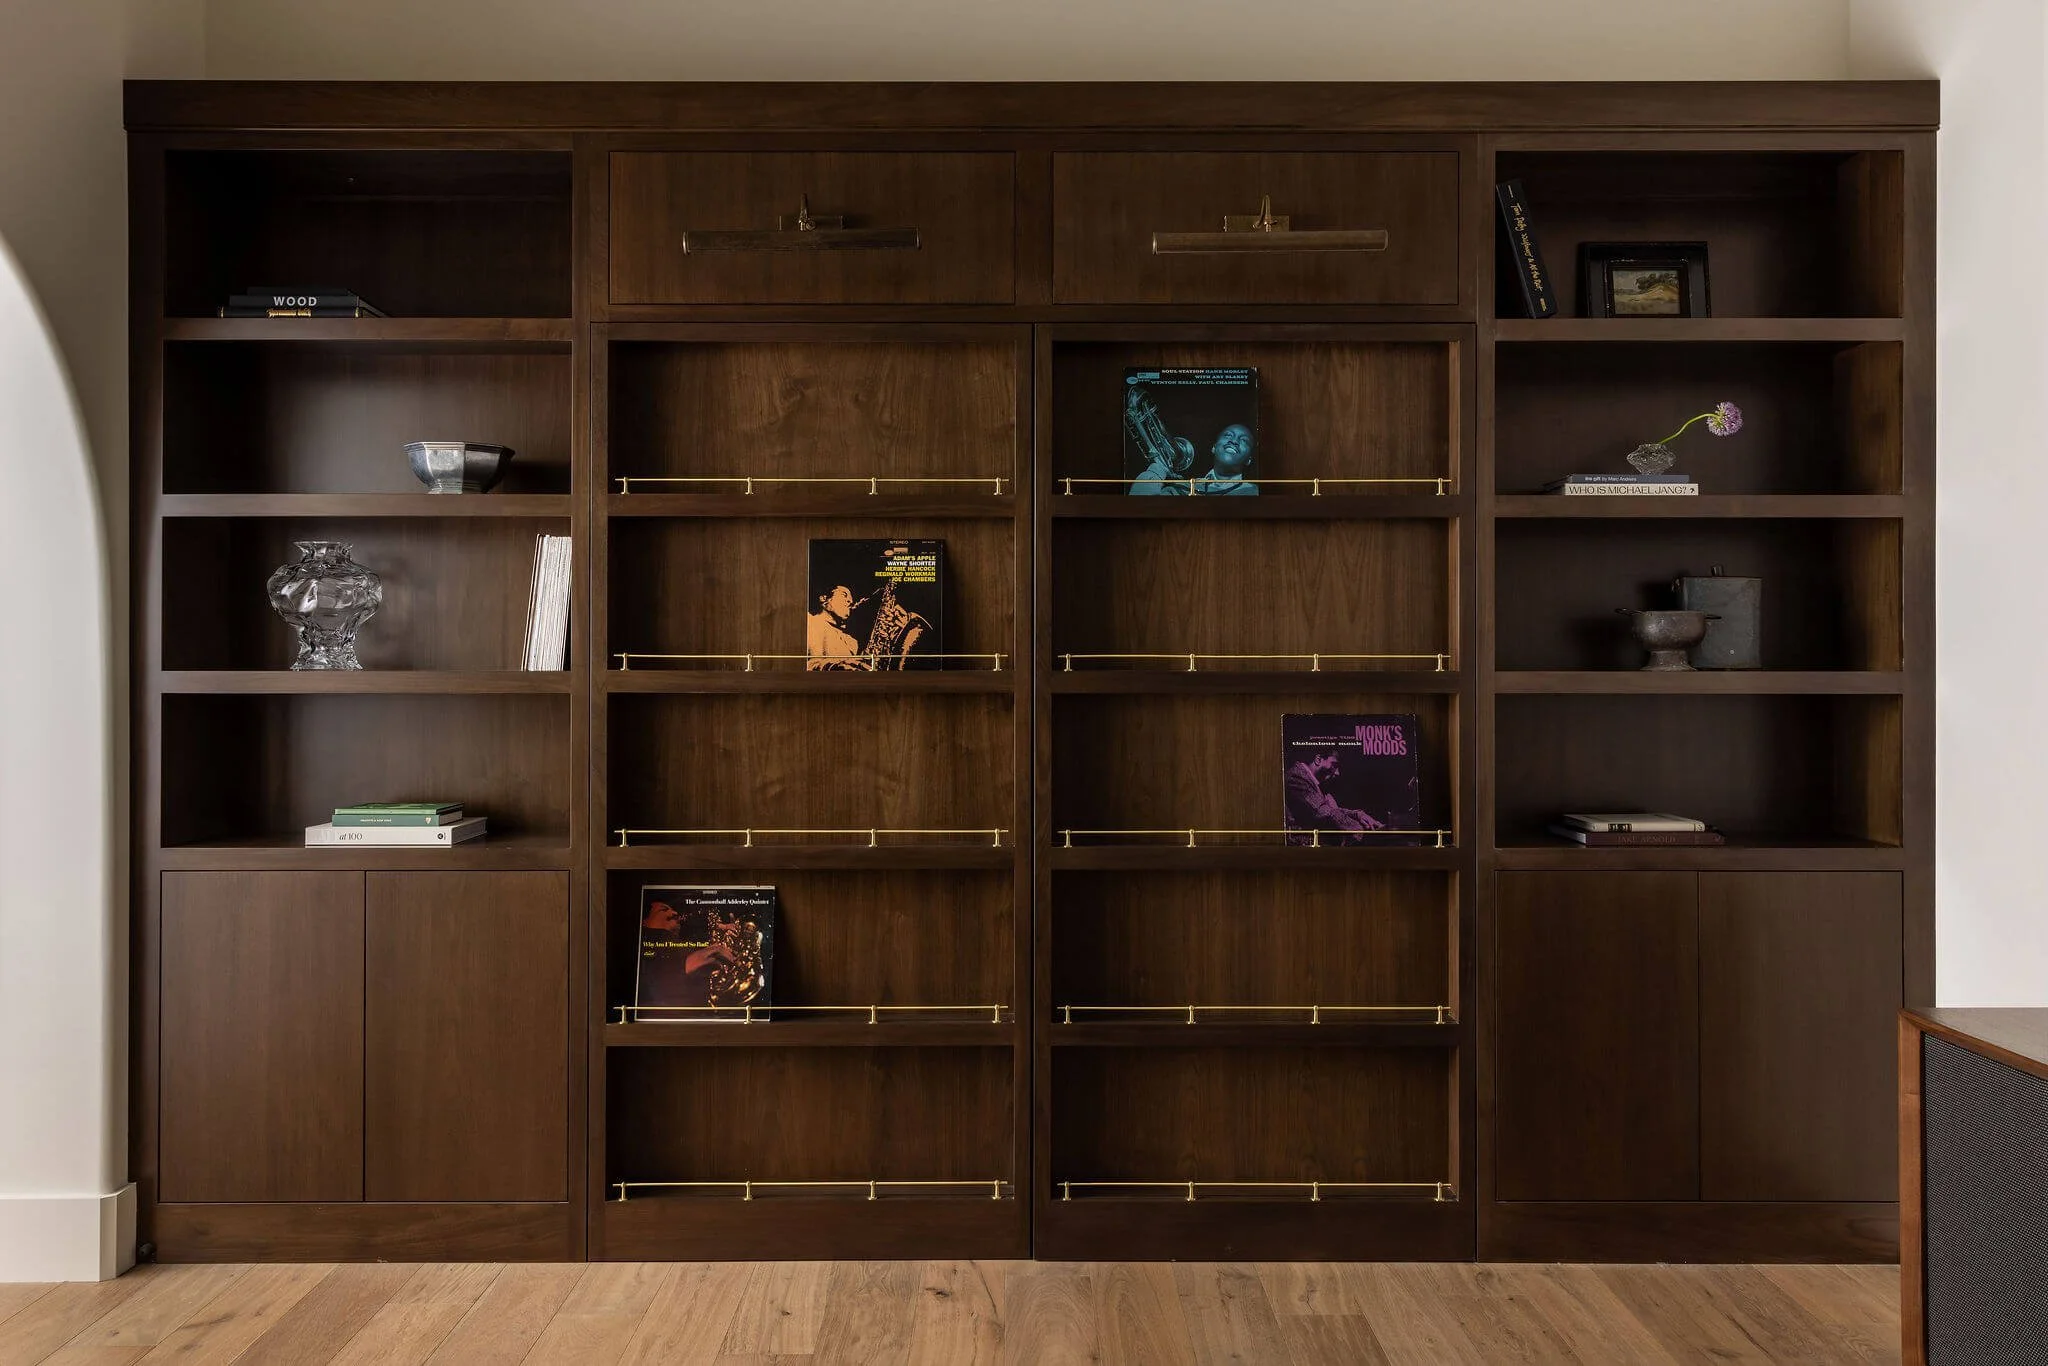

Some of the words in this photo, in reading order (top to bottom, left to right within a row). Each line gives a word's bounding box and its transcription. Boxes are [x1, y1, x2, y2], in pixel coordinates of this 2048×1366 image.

[273, 296, 318, 306] WOOD
[1568, 486, 1595, 494] WHO
[1597, 486, 1607, 494] IS
[1608, 486, 1654, 494] MICHAEL
[1654, 486, 1687, 494] JANG?
[1355, 725, 1403, 740] MONK'S
[1363, 740, 1407, 756] MOODS
[348, 832, 362, 840] 100
